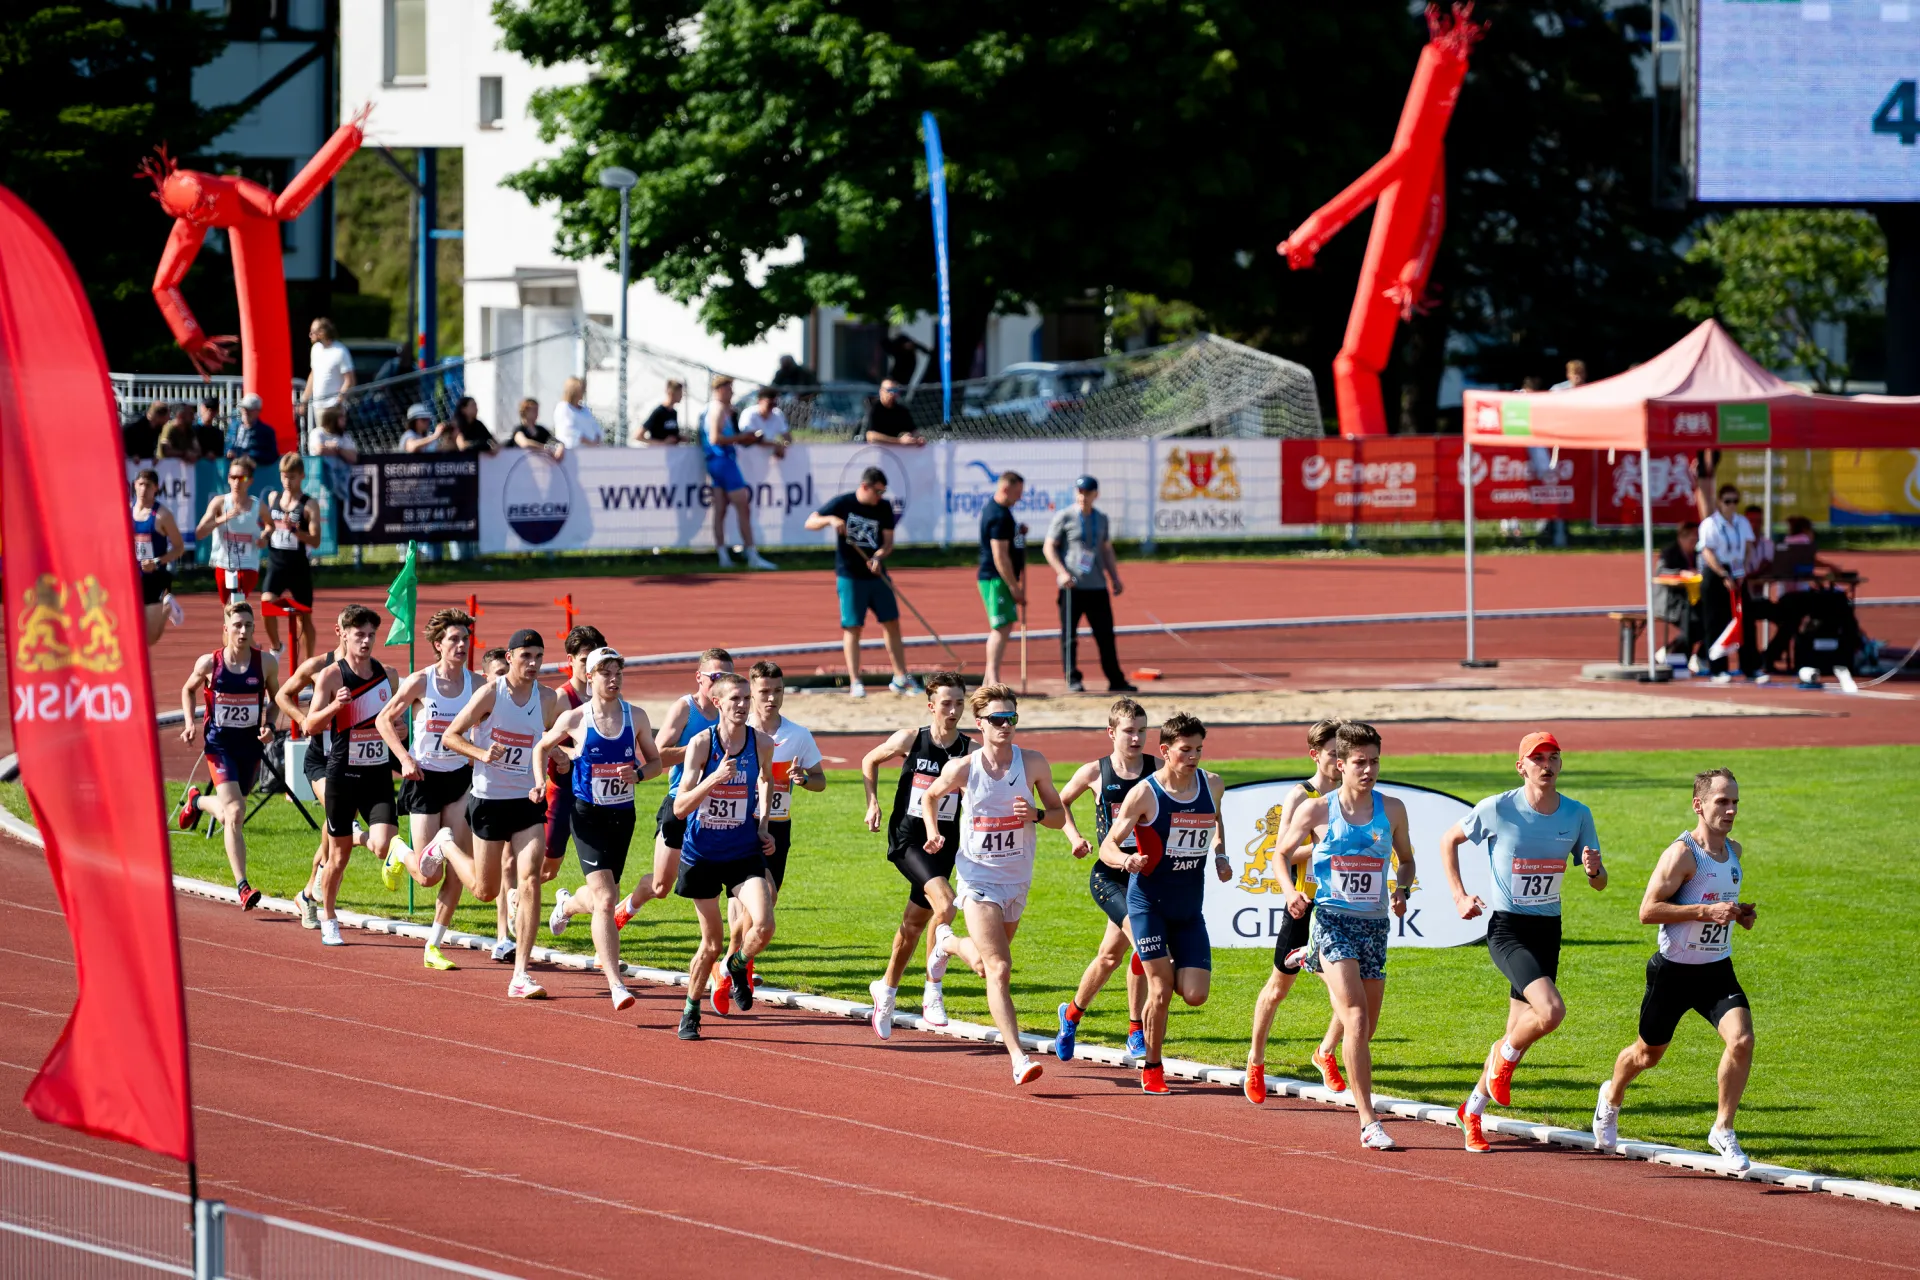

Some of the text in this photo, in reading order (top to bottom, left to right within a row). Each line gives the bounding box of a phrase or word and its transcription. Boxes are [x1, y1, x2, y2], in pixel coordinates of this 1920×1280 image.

[384, 462, 476, 477] SECURITY SERVICE
[1335, 458, 1416, 488] Energa
[1490, 455, 1574, 486] Enea
[599, 475, 813, 513] www.reon.pl
[508, 502, 568, 517] RECON
[1155, 505, 1244, 530] GDAŃSK
[222, 706, 249, 721] 723
[357, 741, 383, 758] 763
[504, 747, 523, 765] 12
[600, 779, 629, 797] 762
[708, 799, 737, 818] 531
[982, 831, 1014, 851] 414
[1177, 829, 1208, 848] 718
[1173, 857, 1199, 872] ŻARY
[1339, 873, 1371, 893] 759
[1521, 875, 1553, 896] 737
[1699, 924, 1729, 943] 521
